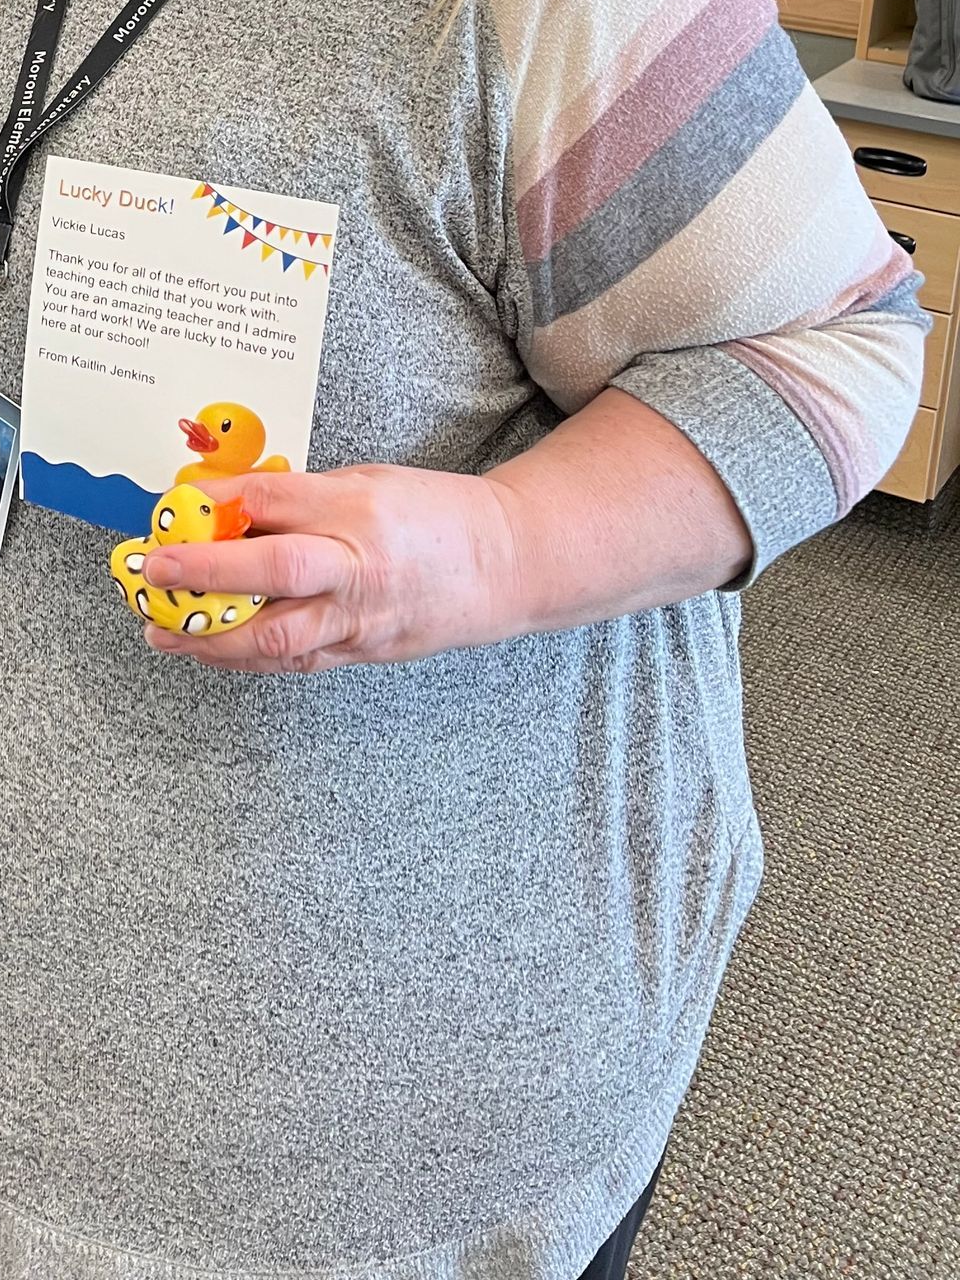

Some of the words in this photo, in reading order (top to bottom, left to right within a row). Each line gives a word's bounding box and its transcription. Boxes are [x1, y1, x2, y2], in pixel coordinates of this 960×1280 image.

[21, 51, 47, 105] Moroni
[59, 178, 113, 208] Lucky
[118, 189, 175, 215] Duck!
[51, 215, 87, 233] Vickie
[90, 223, 126, 241] Lucas
[46, 266, 95, 289] teaching
[98, 278, 128, 293] each
[131, 283, 160, 299] child
[163, 289, 187, 305] that
[189, 296, 213, 310] you
[216, 302, 247, 317] work
[250, 307, 280, 323] with.
[48, 248, 84, 267] Thank
[87, 259, 109, 271] you
[112, 261, 129, 275] for
[131, 266, 146, 279] all
[149, 269, 163, 281] of
[164, 272, 184, 286] the
[187, 277, 220, 293] effort
[223, 285, 247, 298] you
[249, 291, 271, 304] put
[274, 292, 298, 308] into
[40, 314, 67, 331] here
[69, 323, 81, 335] at
[84, 327, 105, 339] our
[42, 300, 69, 313] your
[70, 304, 98, 321] hard
[100, 312, 133, 328] work!
[136, 317, 157, 333] We
[160, 325, 181, 338] are
[184, 327, 217, 348] lucky
[220, 335, 233, 349] to
[236, 337, 268, 356] have
[270, 347, 295, 361] you
[44, 282, 67, 298] You
[70, 290, 90, 302] are
[92, 295, 108, 306] an
[111, 298, 163, 320] amazing
[166, 307, 214, 328] teacher
[216, 320, 241, 333] and
[244, 322, 249, 335] I
[251, 327, 297, 344] admire
[38, 347, 68, 364] From
[71, 354, 107, 374] Kaitlin
[109, 364, 156, 385] Jenkins
